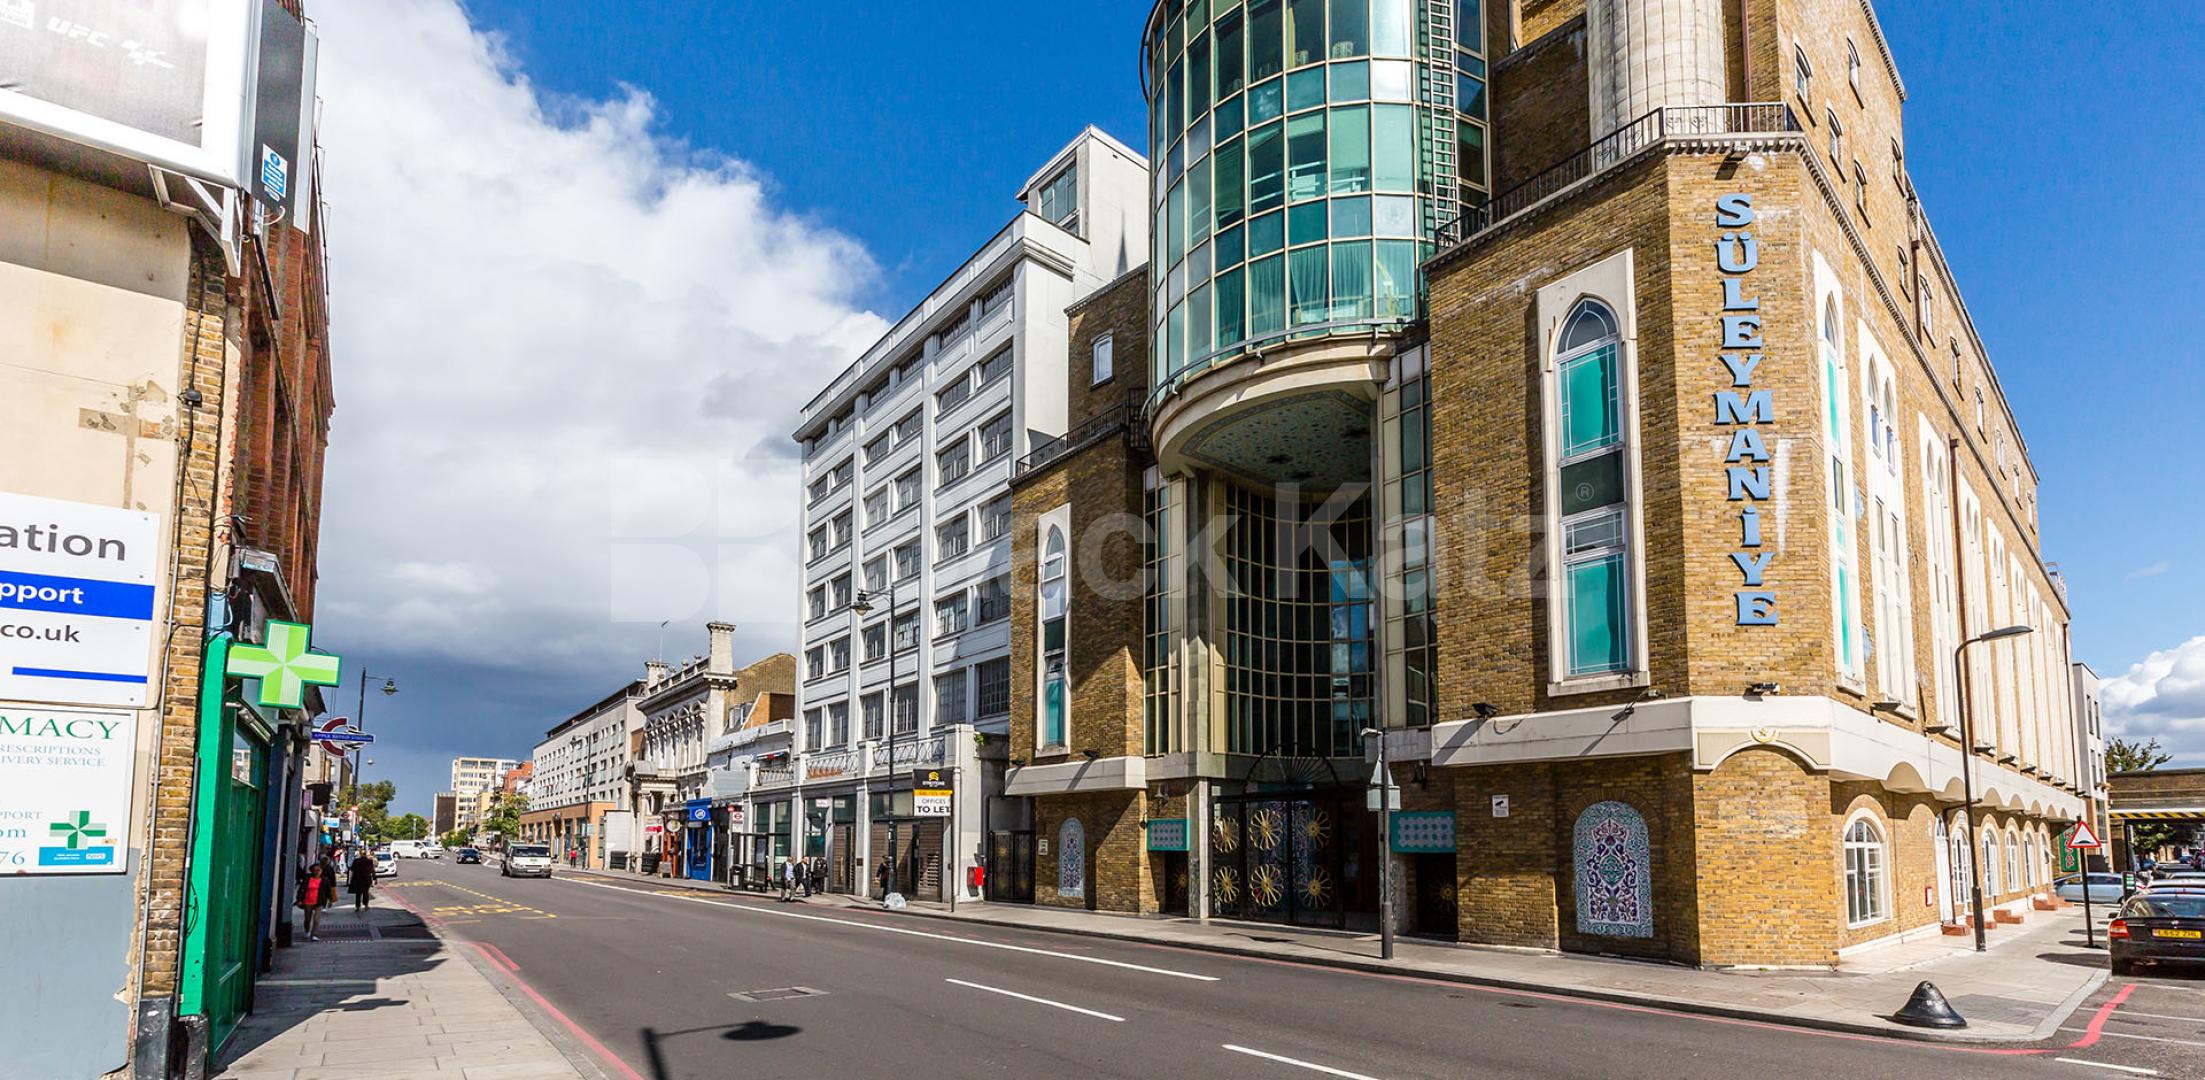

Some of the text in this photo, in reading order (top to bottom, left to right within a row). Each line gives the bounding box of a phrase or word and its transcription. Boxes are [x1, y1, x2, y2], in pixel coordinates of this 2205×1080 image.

[47, 16, 110, 48] UFC
[0, 523, 126, 561] ation
[0, 715, 120, 740] MACY
[916, 805, 931, 813] TO
